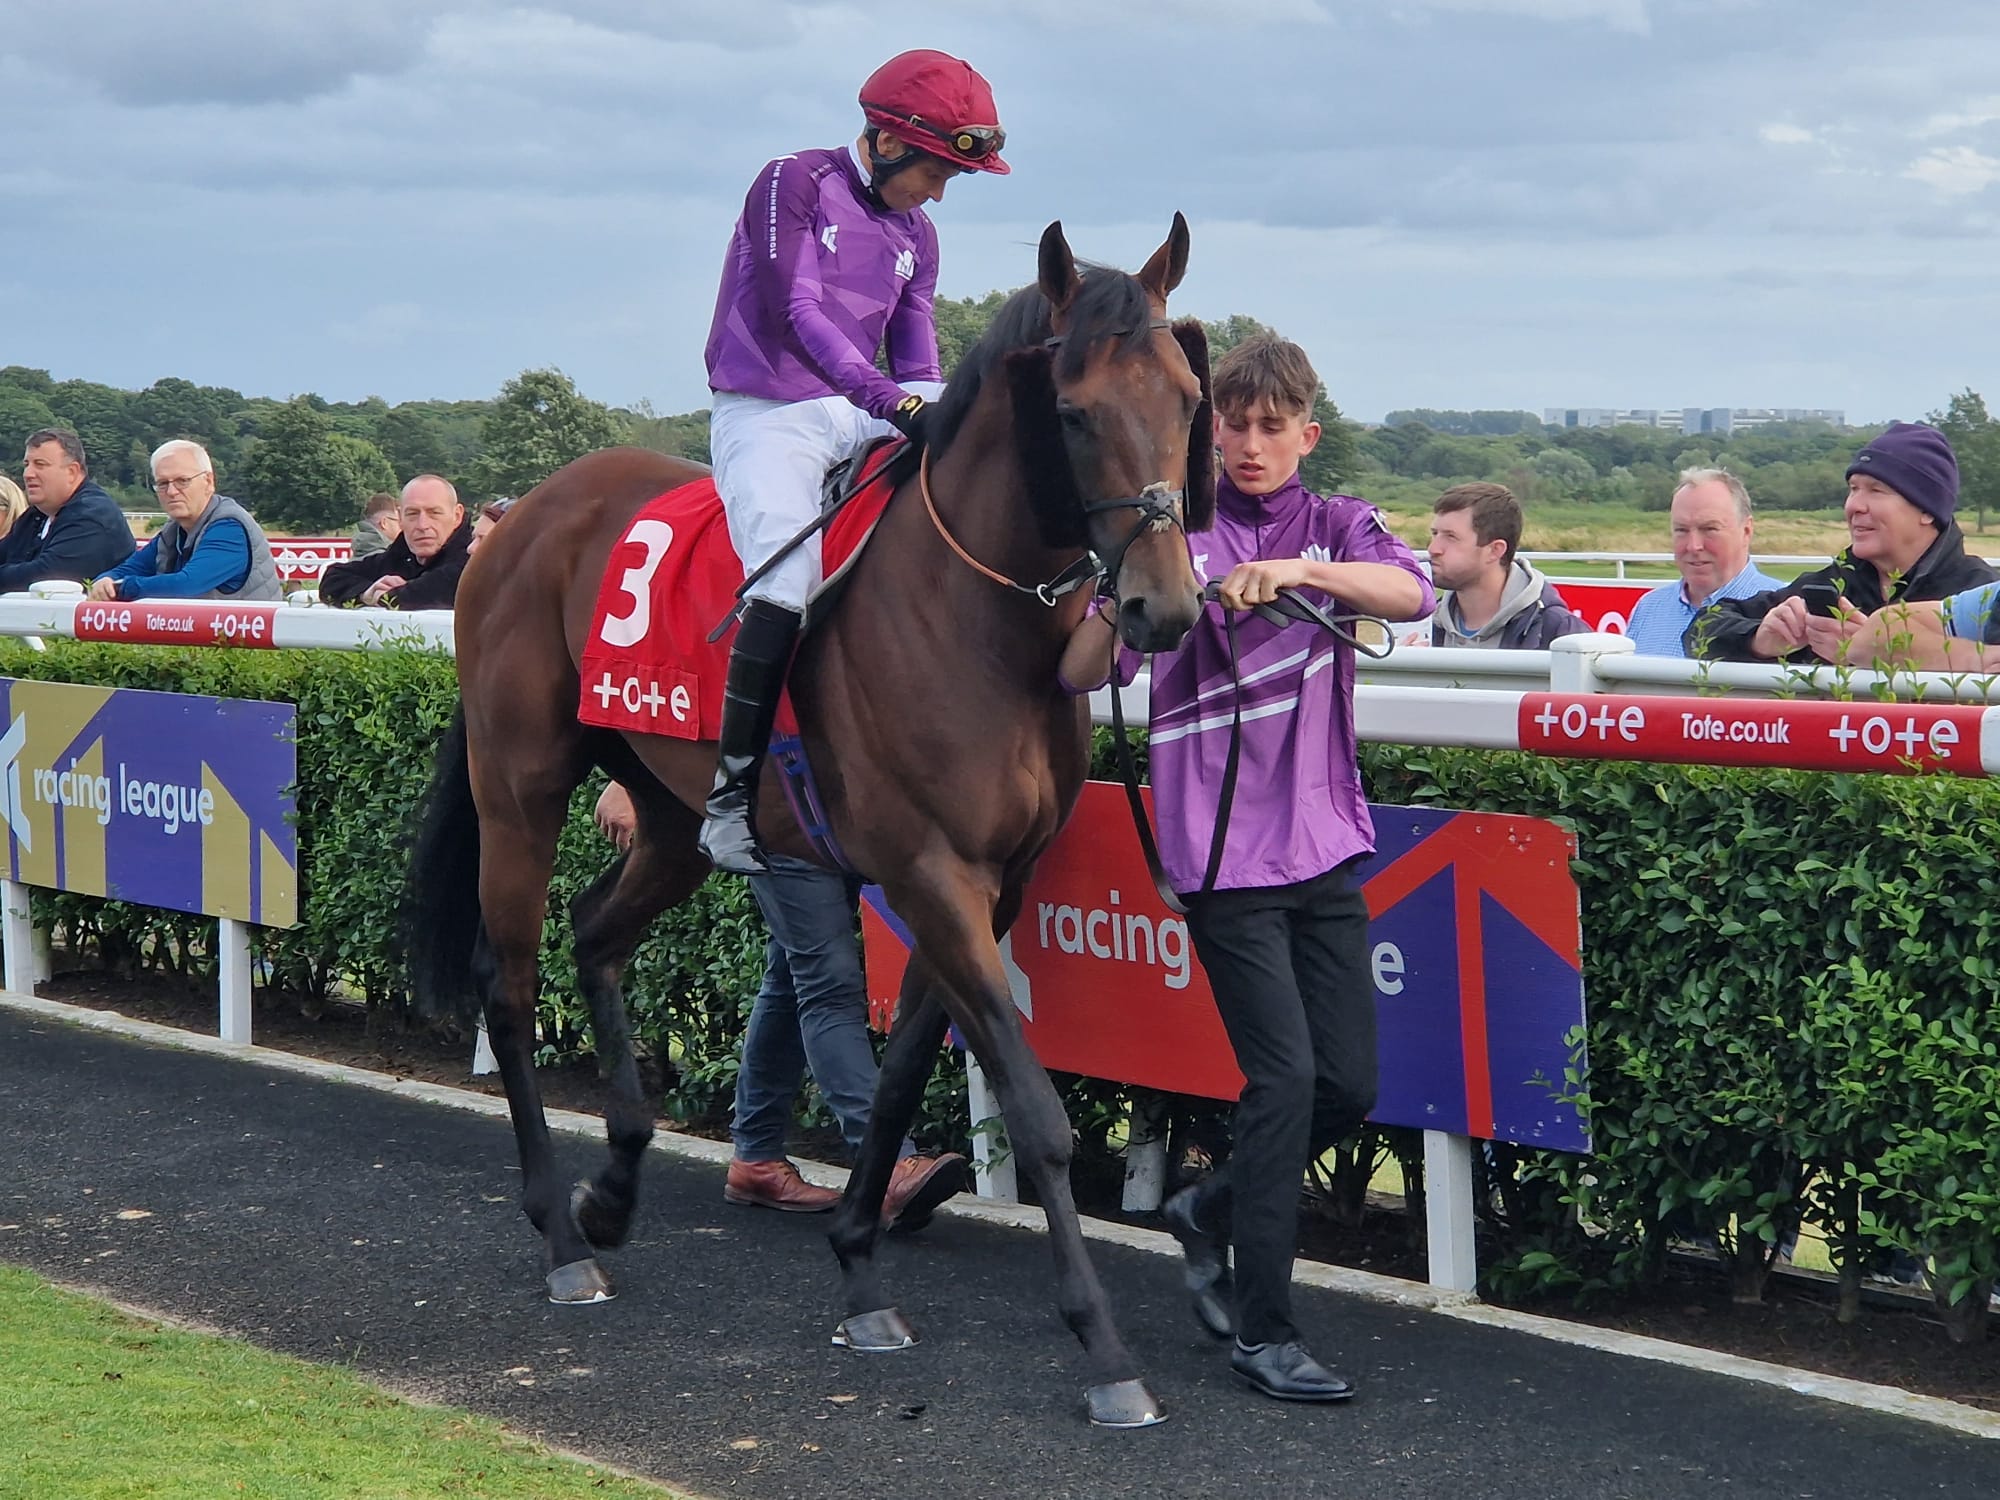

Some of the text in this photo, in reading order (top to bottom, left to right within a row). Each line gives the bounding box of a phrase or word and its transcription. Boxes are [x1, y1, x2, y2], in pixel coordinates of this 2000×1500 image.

[773, 161, 784, 177] THE
[770, 180, 778, 224] WINNERS
[600, 519, 674, 648] 3
[81, 607, 133, 633] tote
[146, 613, 195, 633] Tote.co.uk
[592, 672, 691, 722] tote
[1534, 702, 1646, 742] tote
[1681, 713, 1790, 744] Tote.co.uk
[33, 757, 214, 835] racing league
[1038, 889, 1191, 990] racing
